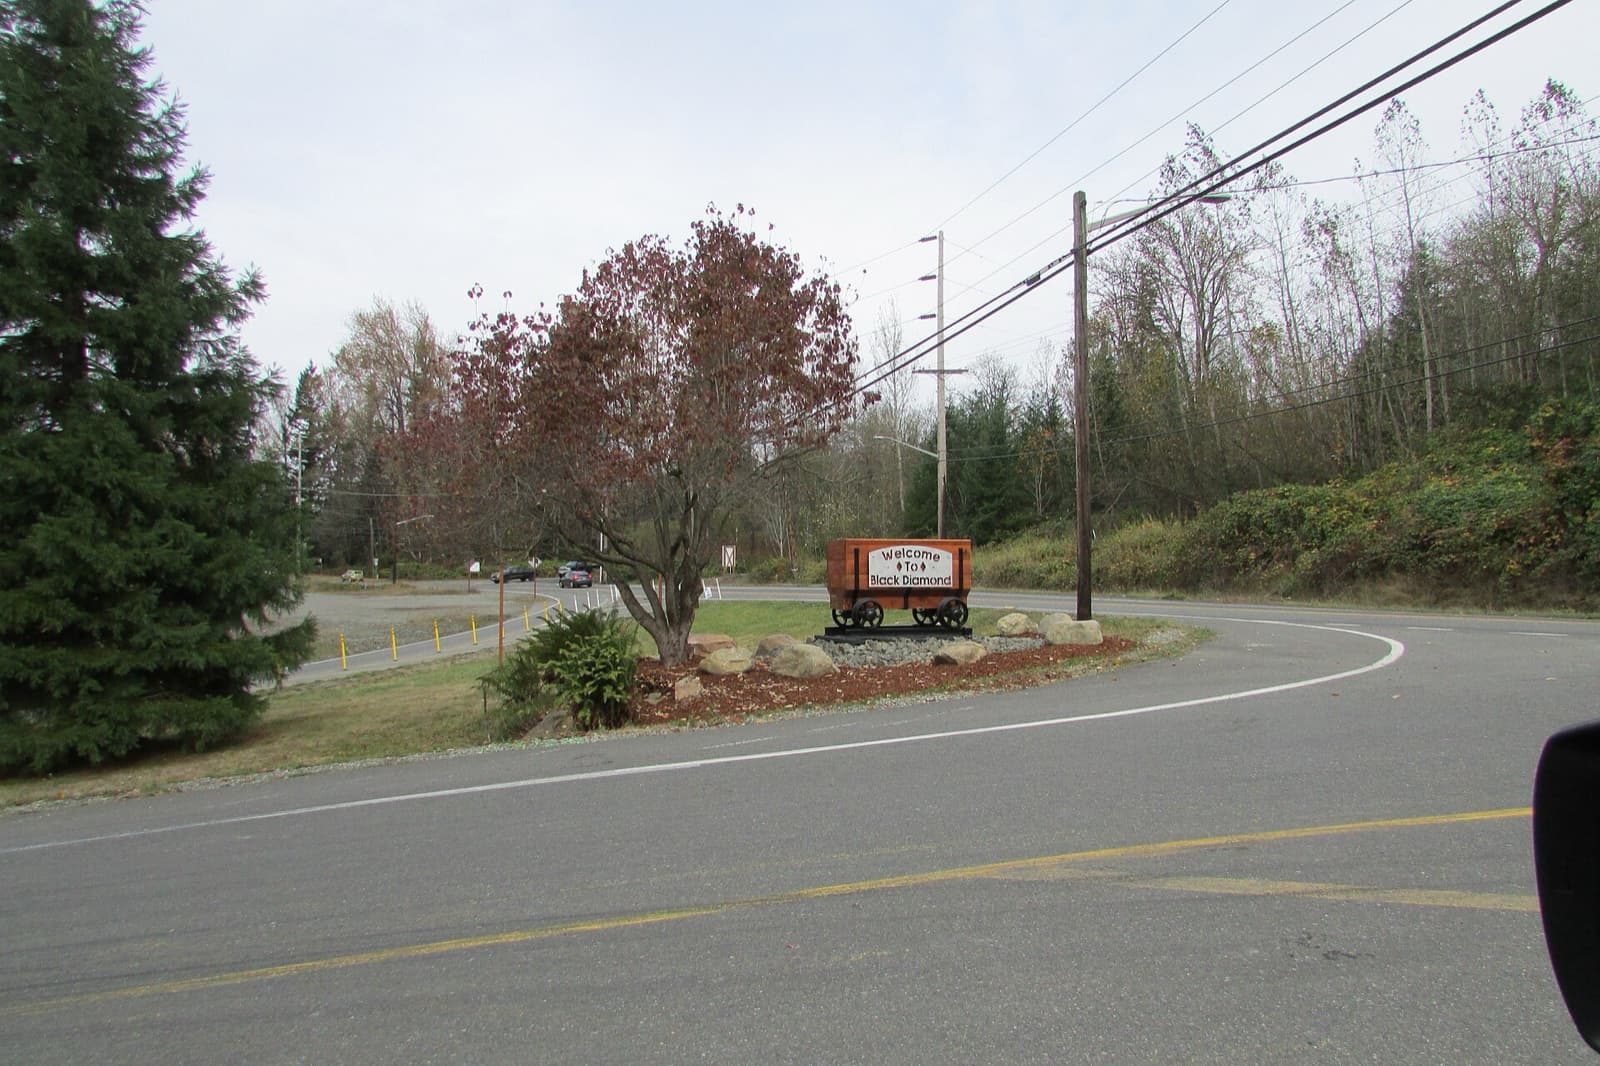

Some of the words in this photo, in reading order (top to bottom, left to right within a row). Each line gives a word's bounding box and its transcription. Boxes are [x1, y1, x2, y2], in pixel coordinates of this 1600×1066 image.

[882, 548, 940, 562] Welcome
[905, 562, 918, 572] To
[870, 575, 900, 585] Black
[902, 575, 951, 585] Diamond
